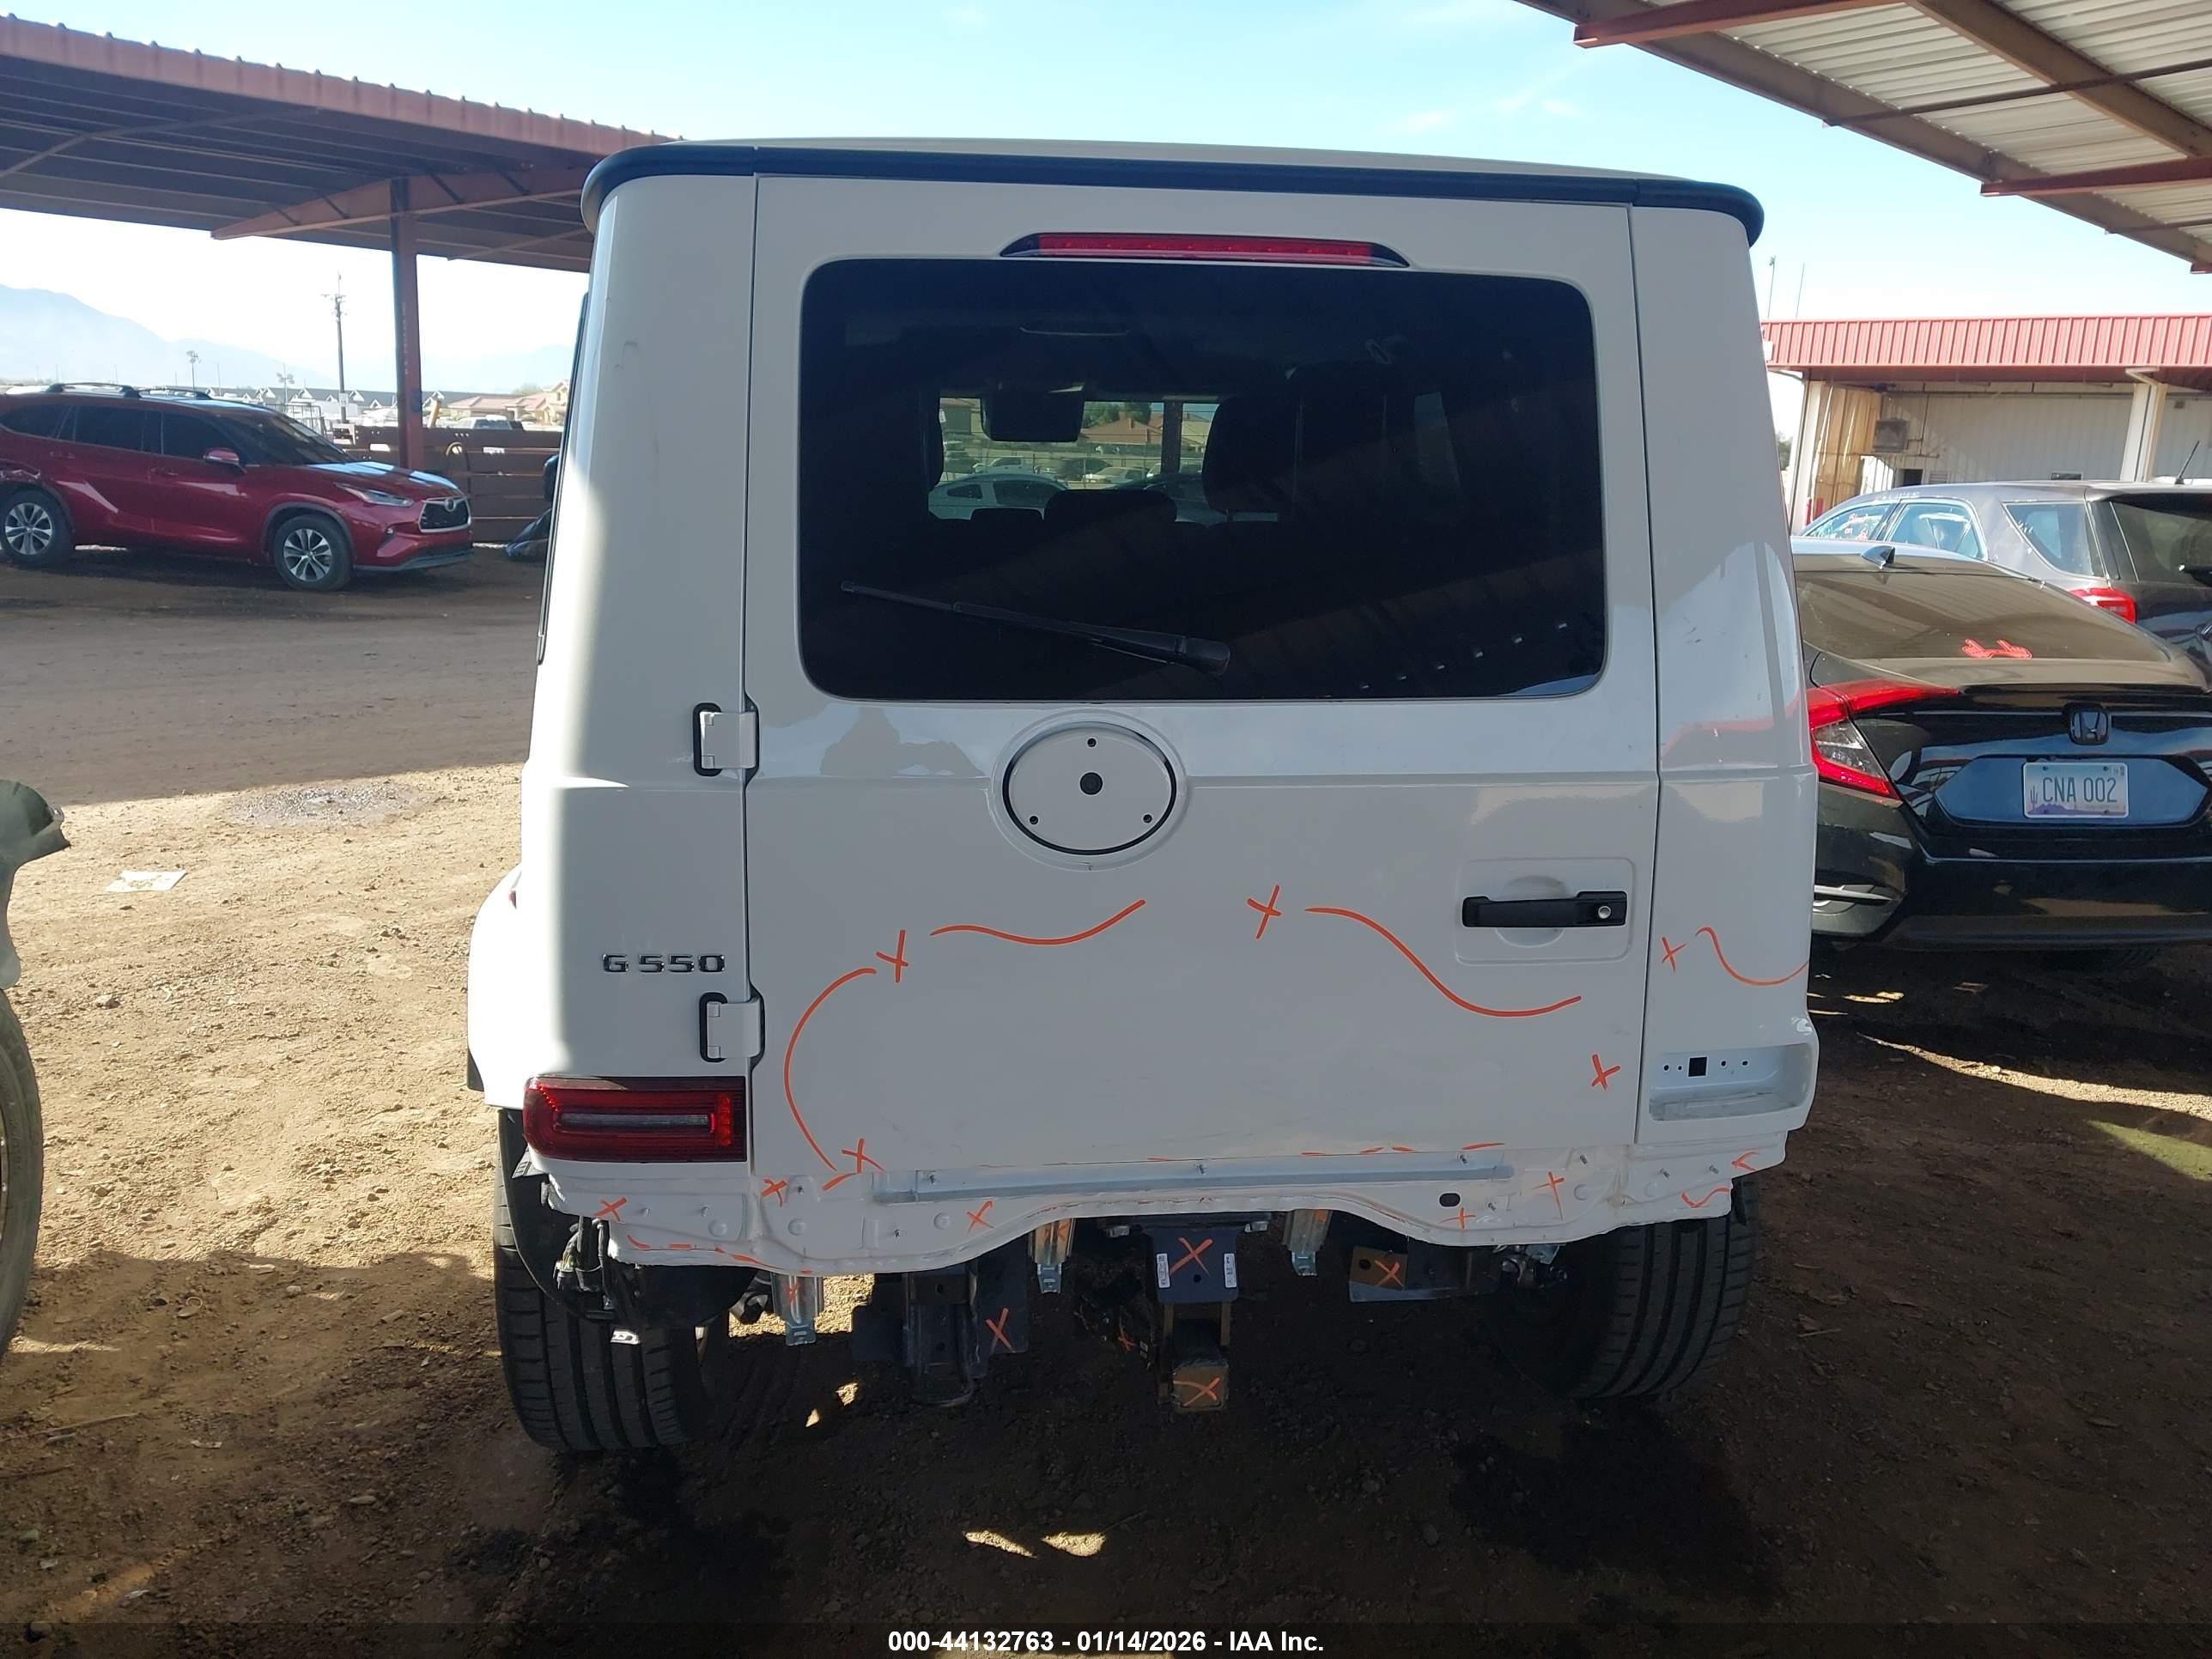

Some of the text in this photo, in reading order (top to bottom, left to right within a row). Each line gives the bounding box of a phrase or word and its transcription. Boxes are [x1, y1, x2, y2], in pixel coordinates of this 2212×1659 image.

[2043, 777, 2118, 803] CNA 002
[602, 954, 726, 974] G 550
